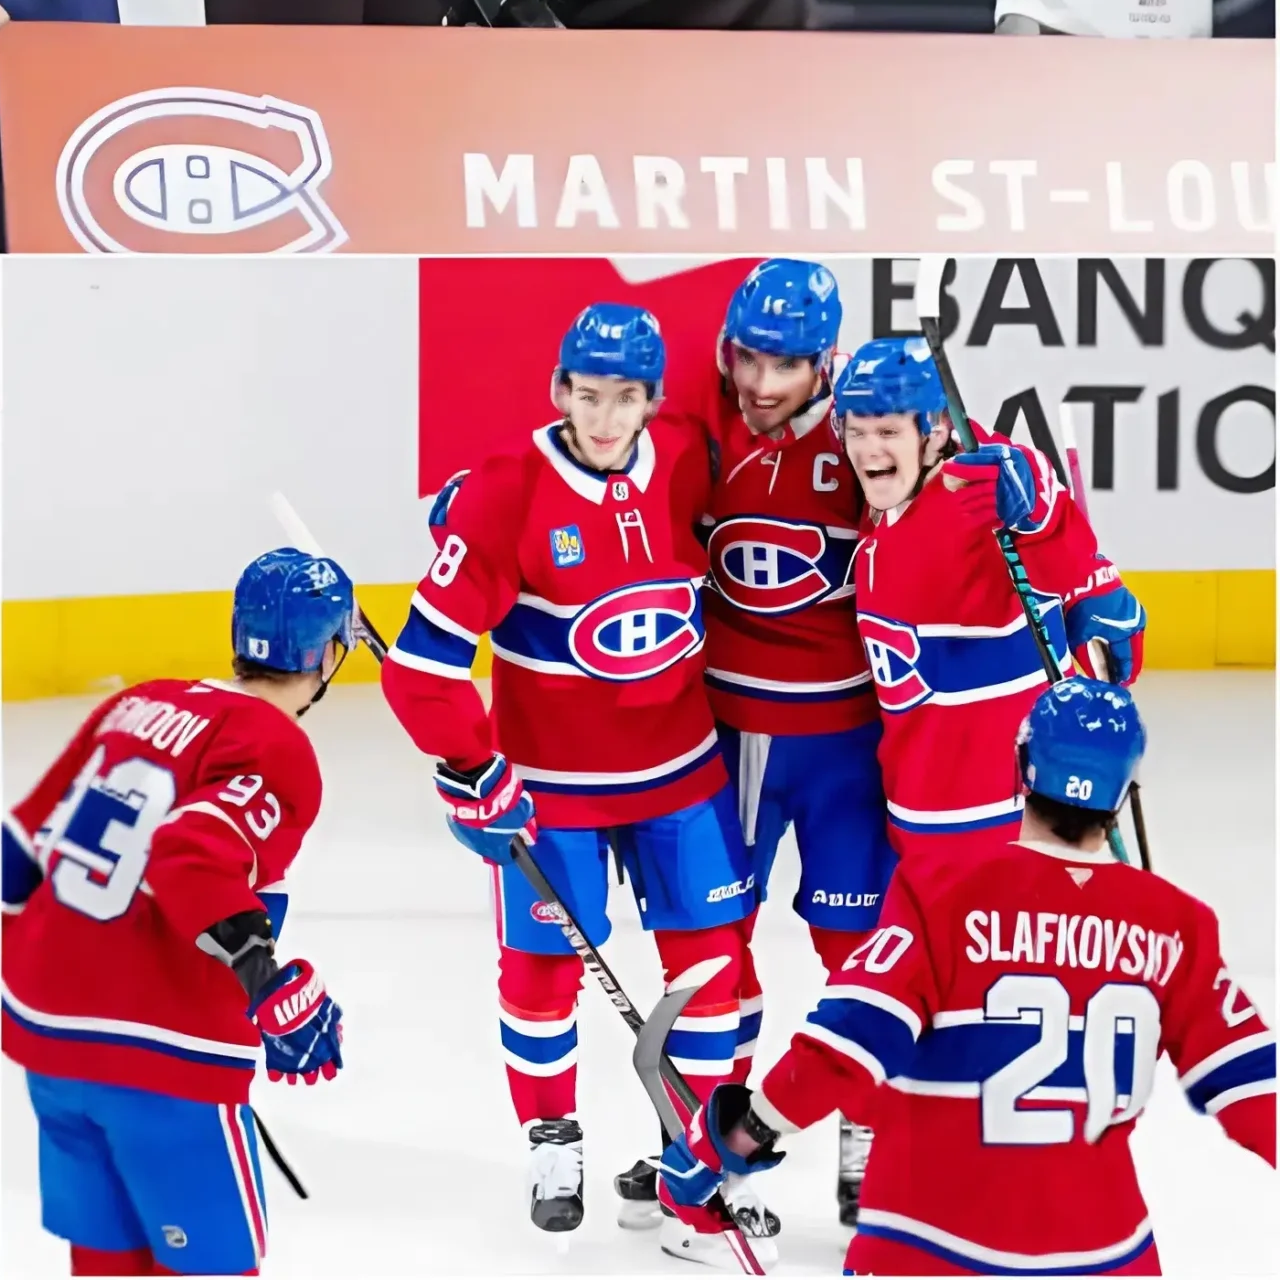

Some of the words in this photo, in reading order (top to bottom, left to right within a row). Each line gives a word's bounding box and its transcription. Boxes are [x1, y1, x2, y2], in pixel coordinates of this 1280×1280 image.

[463, 152, 867, 231] MARTIN
[813, 453, 838, 492] C
[1065, 776, 1093, 801] 20
[980, 974, 1162, 1147] 20
